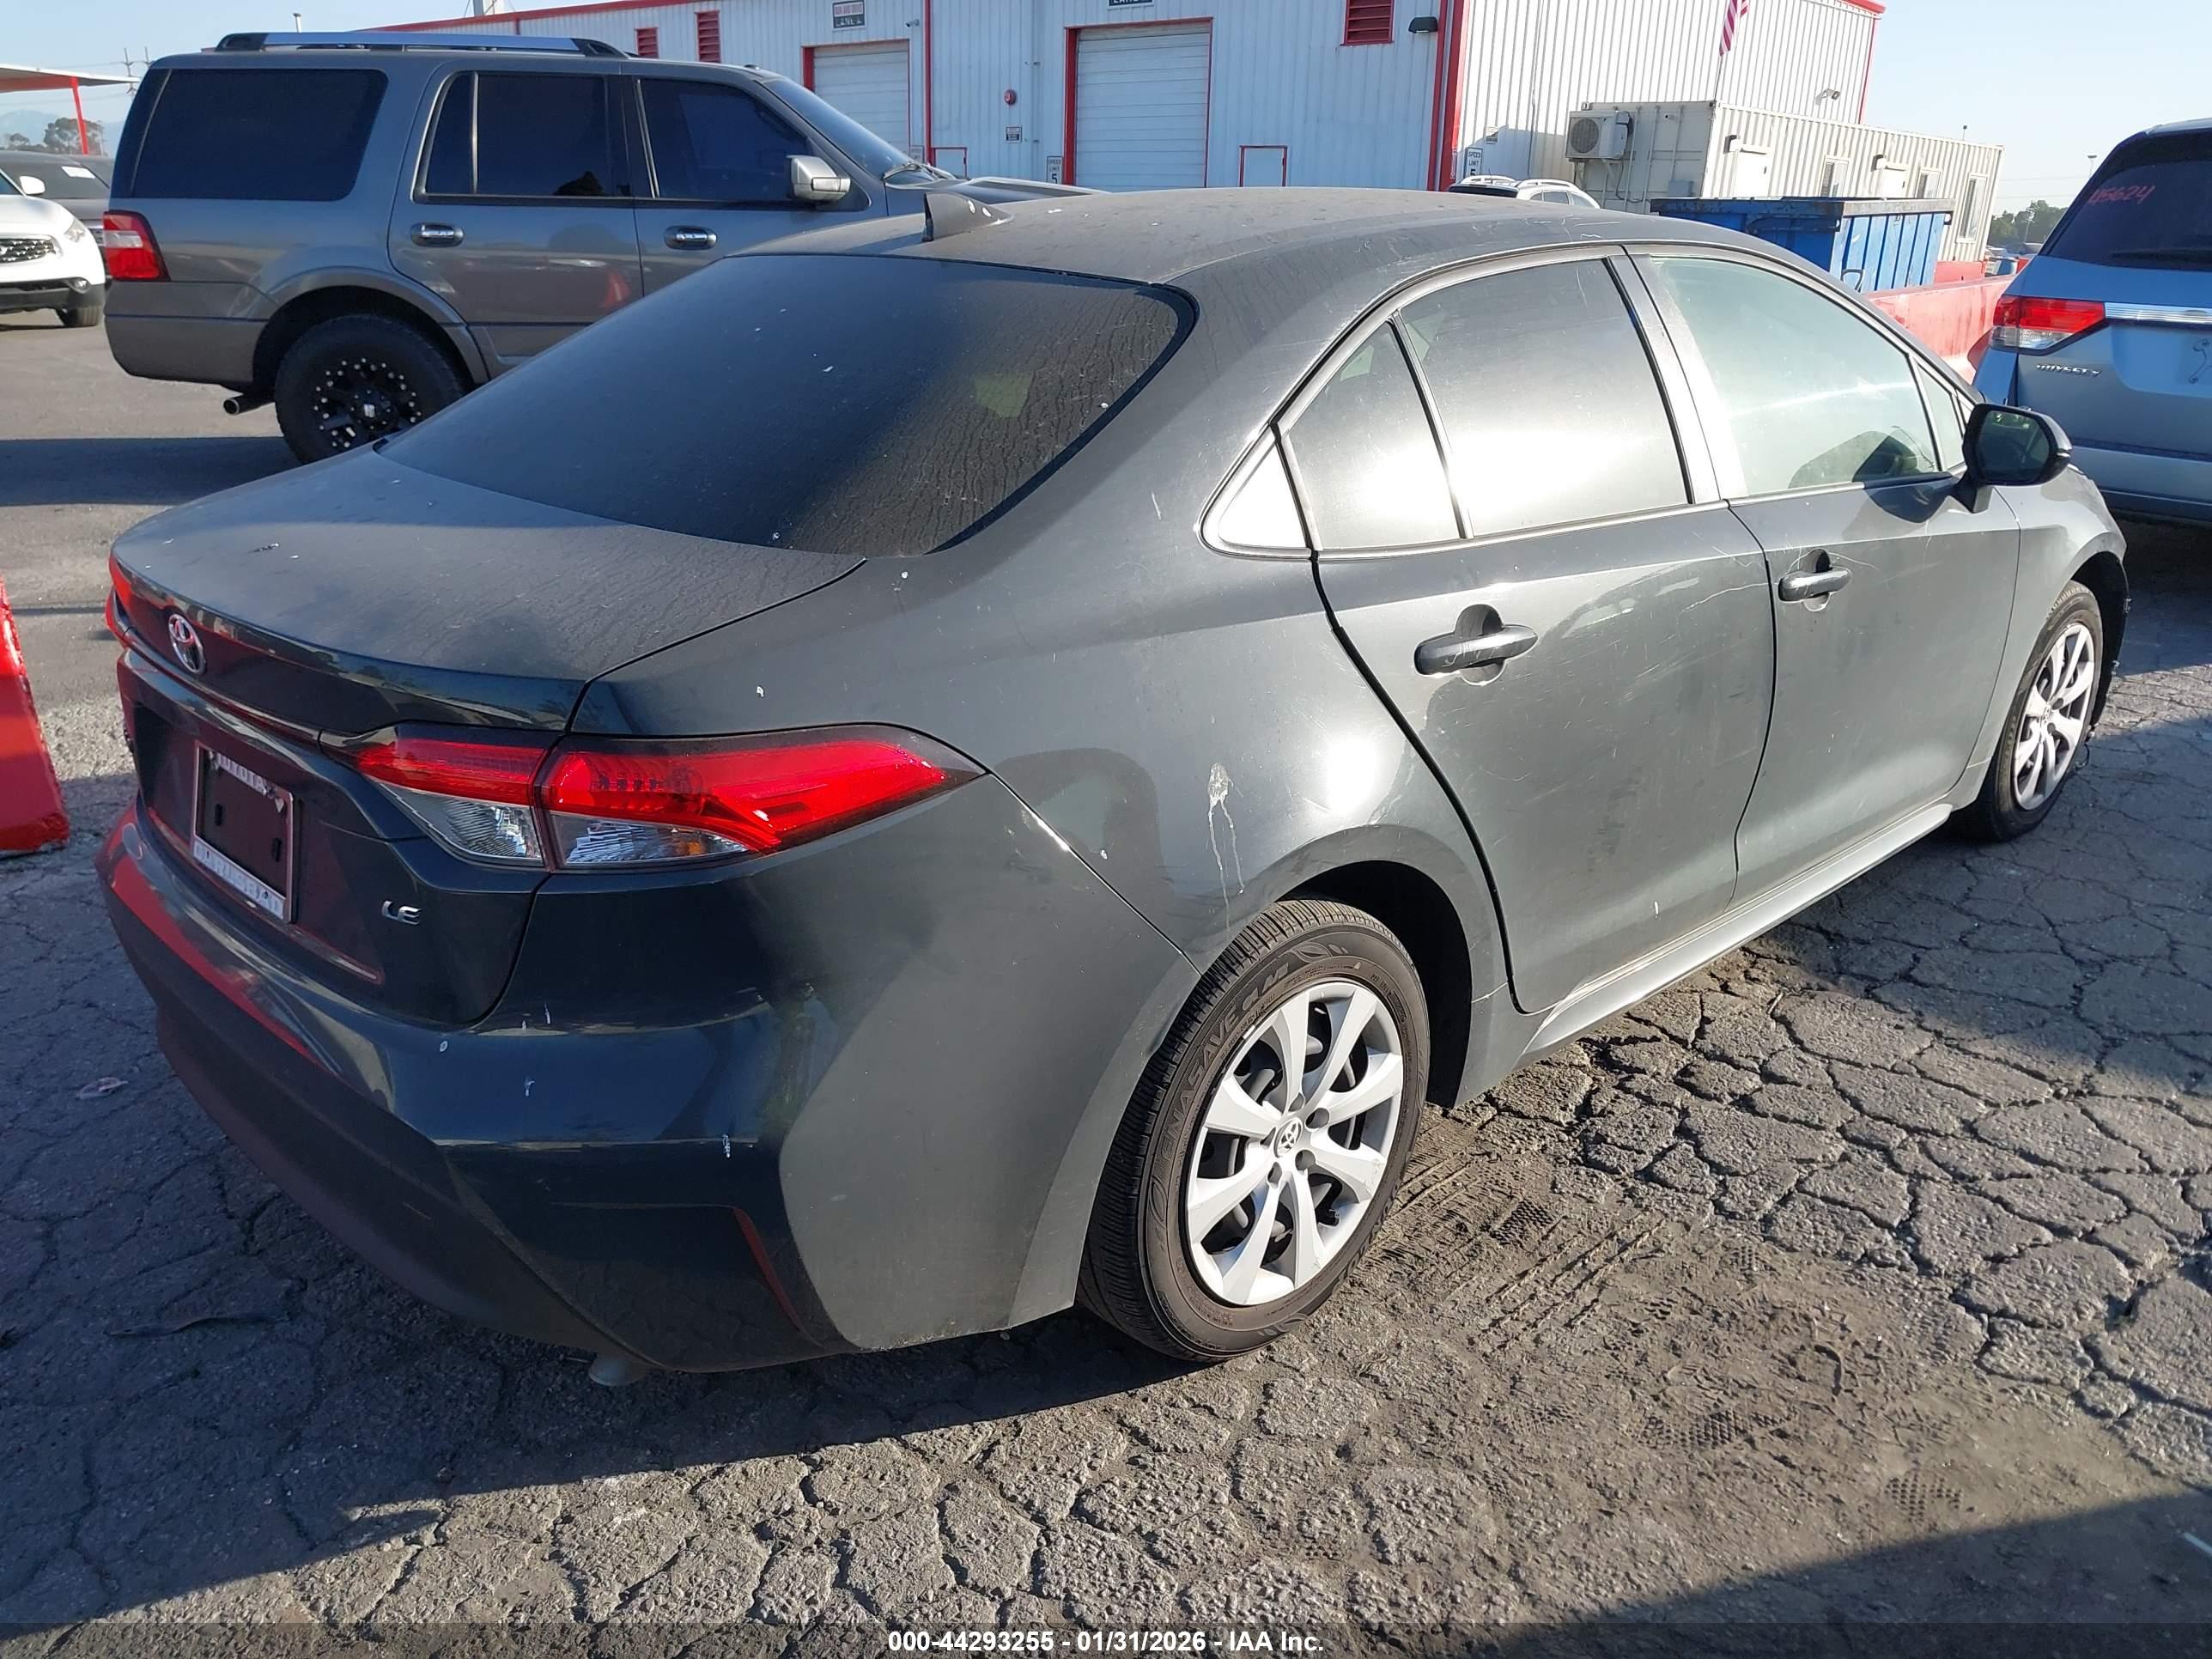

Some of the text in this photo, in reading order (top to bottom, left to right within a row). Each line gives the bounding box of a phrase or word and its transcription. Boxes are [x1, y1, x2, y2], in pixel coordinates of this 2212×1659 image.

[1051, 173, 1058, 184] 5
[2036, 364, 2102, 378] ODYSSEY
[381, 900, 422, 925] LE
